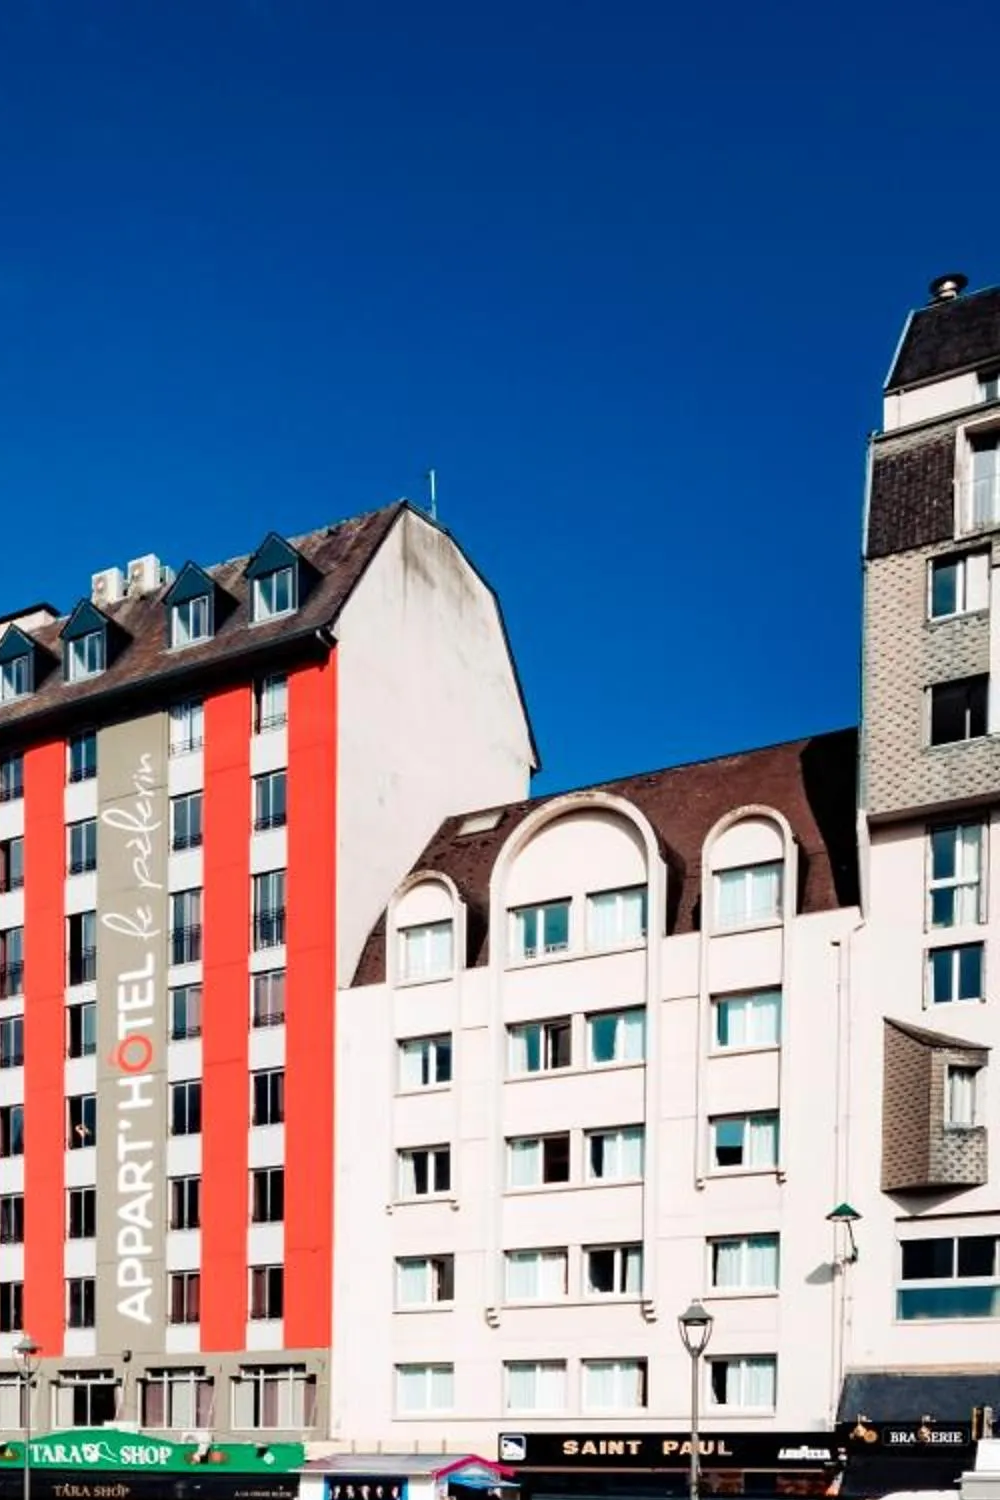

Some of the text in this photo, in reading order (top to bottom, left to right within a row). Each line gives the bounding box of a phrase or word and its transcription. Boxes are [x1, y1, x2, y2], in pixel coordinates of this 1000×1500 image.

[101, 904, 161, 941] le
[890, 1431, 963, 1443] BRASERIE
[30, 1443, 172, 1465] TARA SHOP
[562, 1440, 733, 1456] SAINT PAUL
[93, 1485, 130, 1498] SHOP
